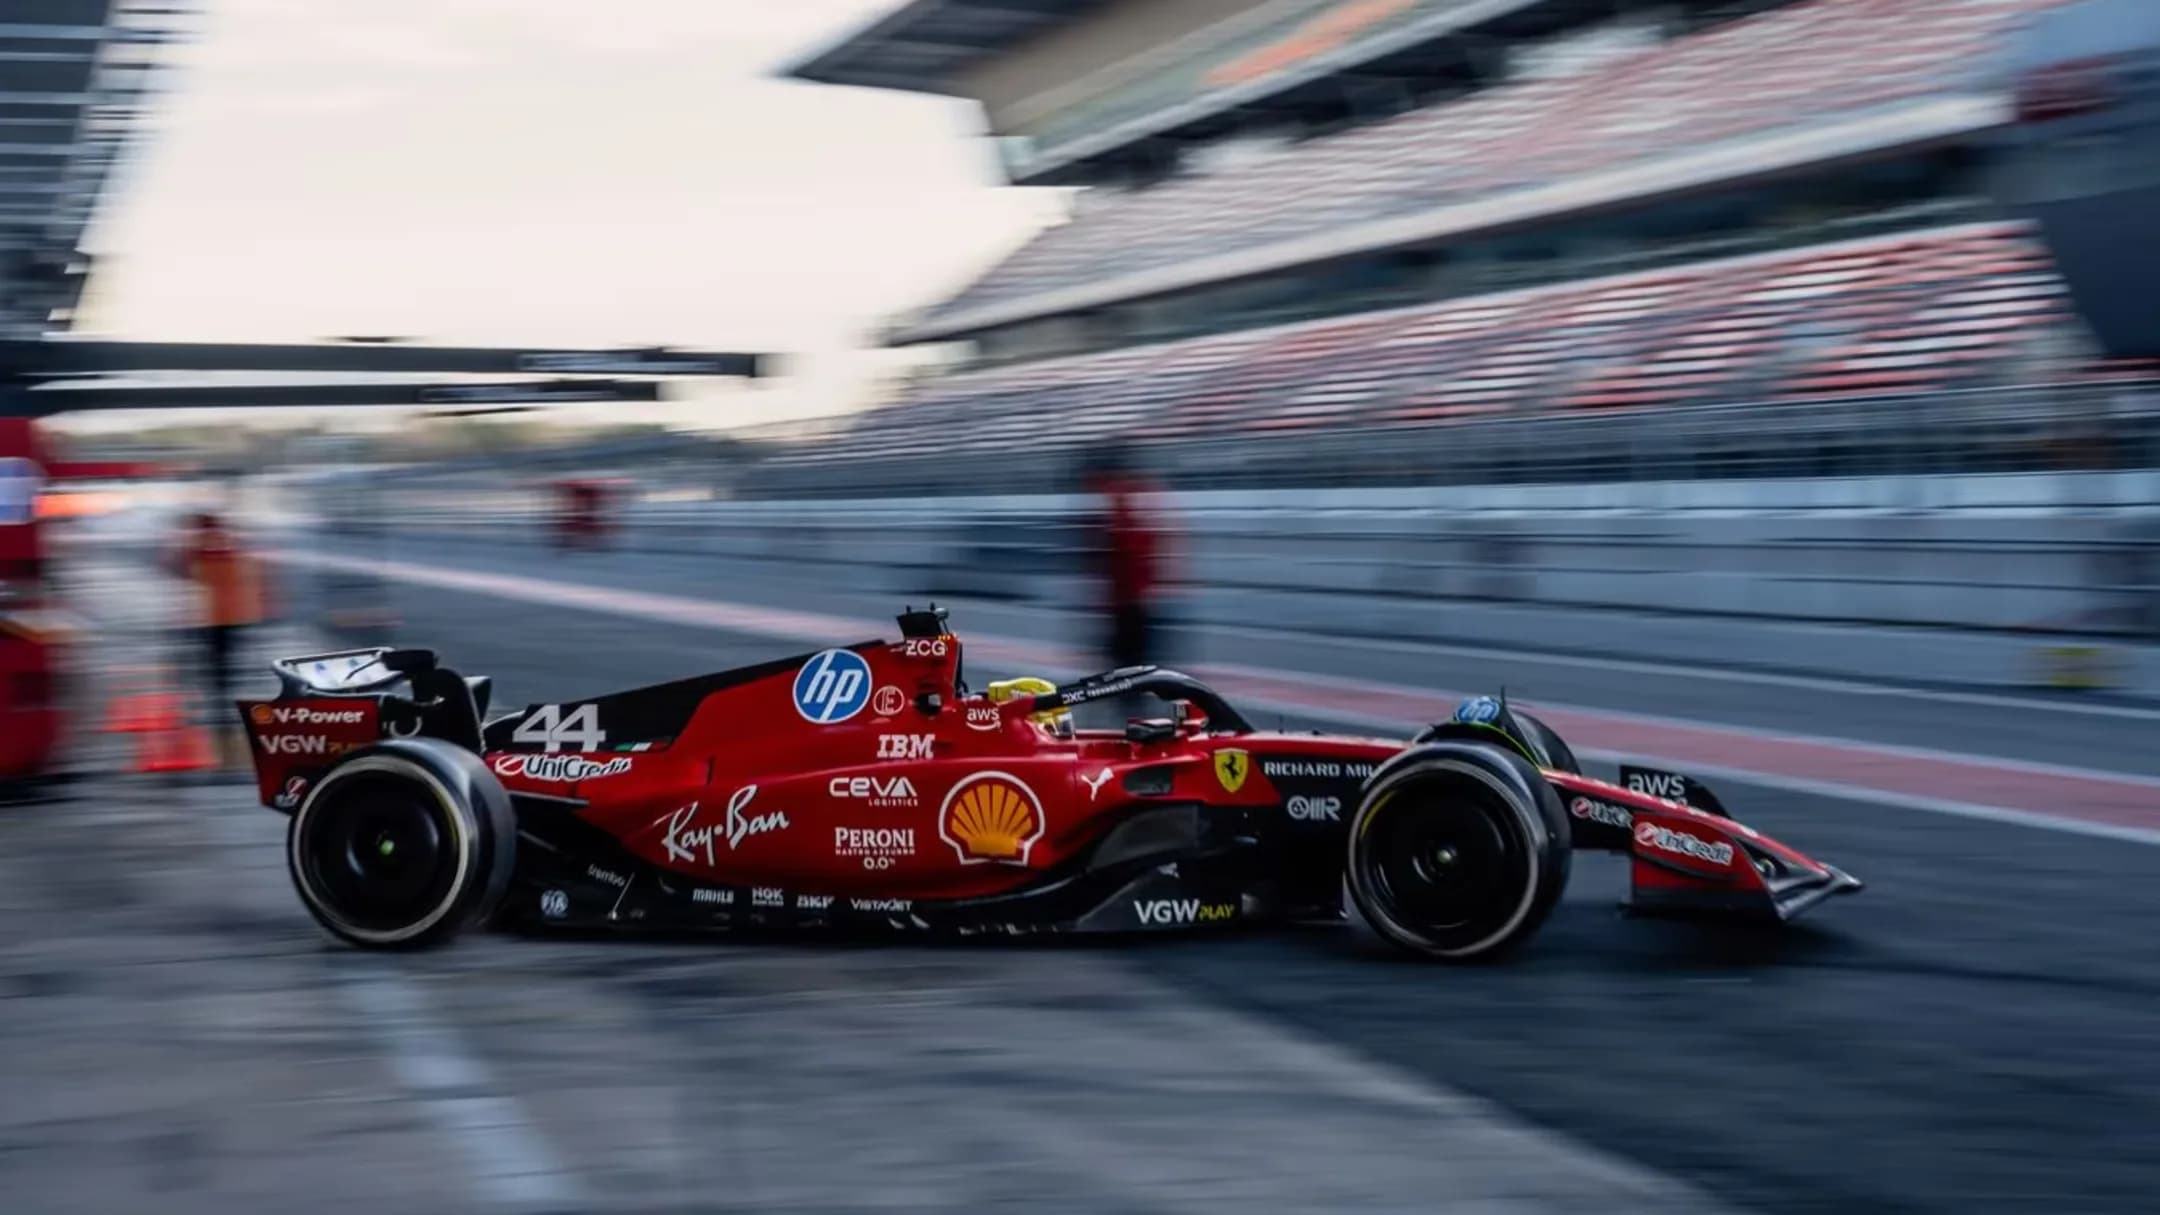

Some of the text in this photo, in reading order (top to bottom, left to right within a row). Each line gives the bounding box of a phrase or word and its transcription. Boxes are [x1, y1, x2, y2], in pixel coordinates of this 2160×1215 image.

[905, 640, 946, 656] ZCG
[802, 650, 863, 720] hp
[273, 708, 364, 723] V-Power
[967, 708, 1000, 721] aws
[512, 704, 606, 753] 44
[259, 735, 327, 754] VGW
[877, 734, 936, 759] IBM
[525, 755, 633, 781] UniCredit
[1264, 762, 1374, 777] RICHARD MIL
[1629, 773, 1685, 796] aws
[835, 827, 915, 848] PERONI
[1134, 899, 1235, 924] VGW PLAY
